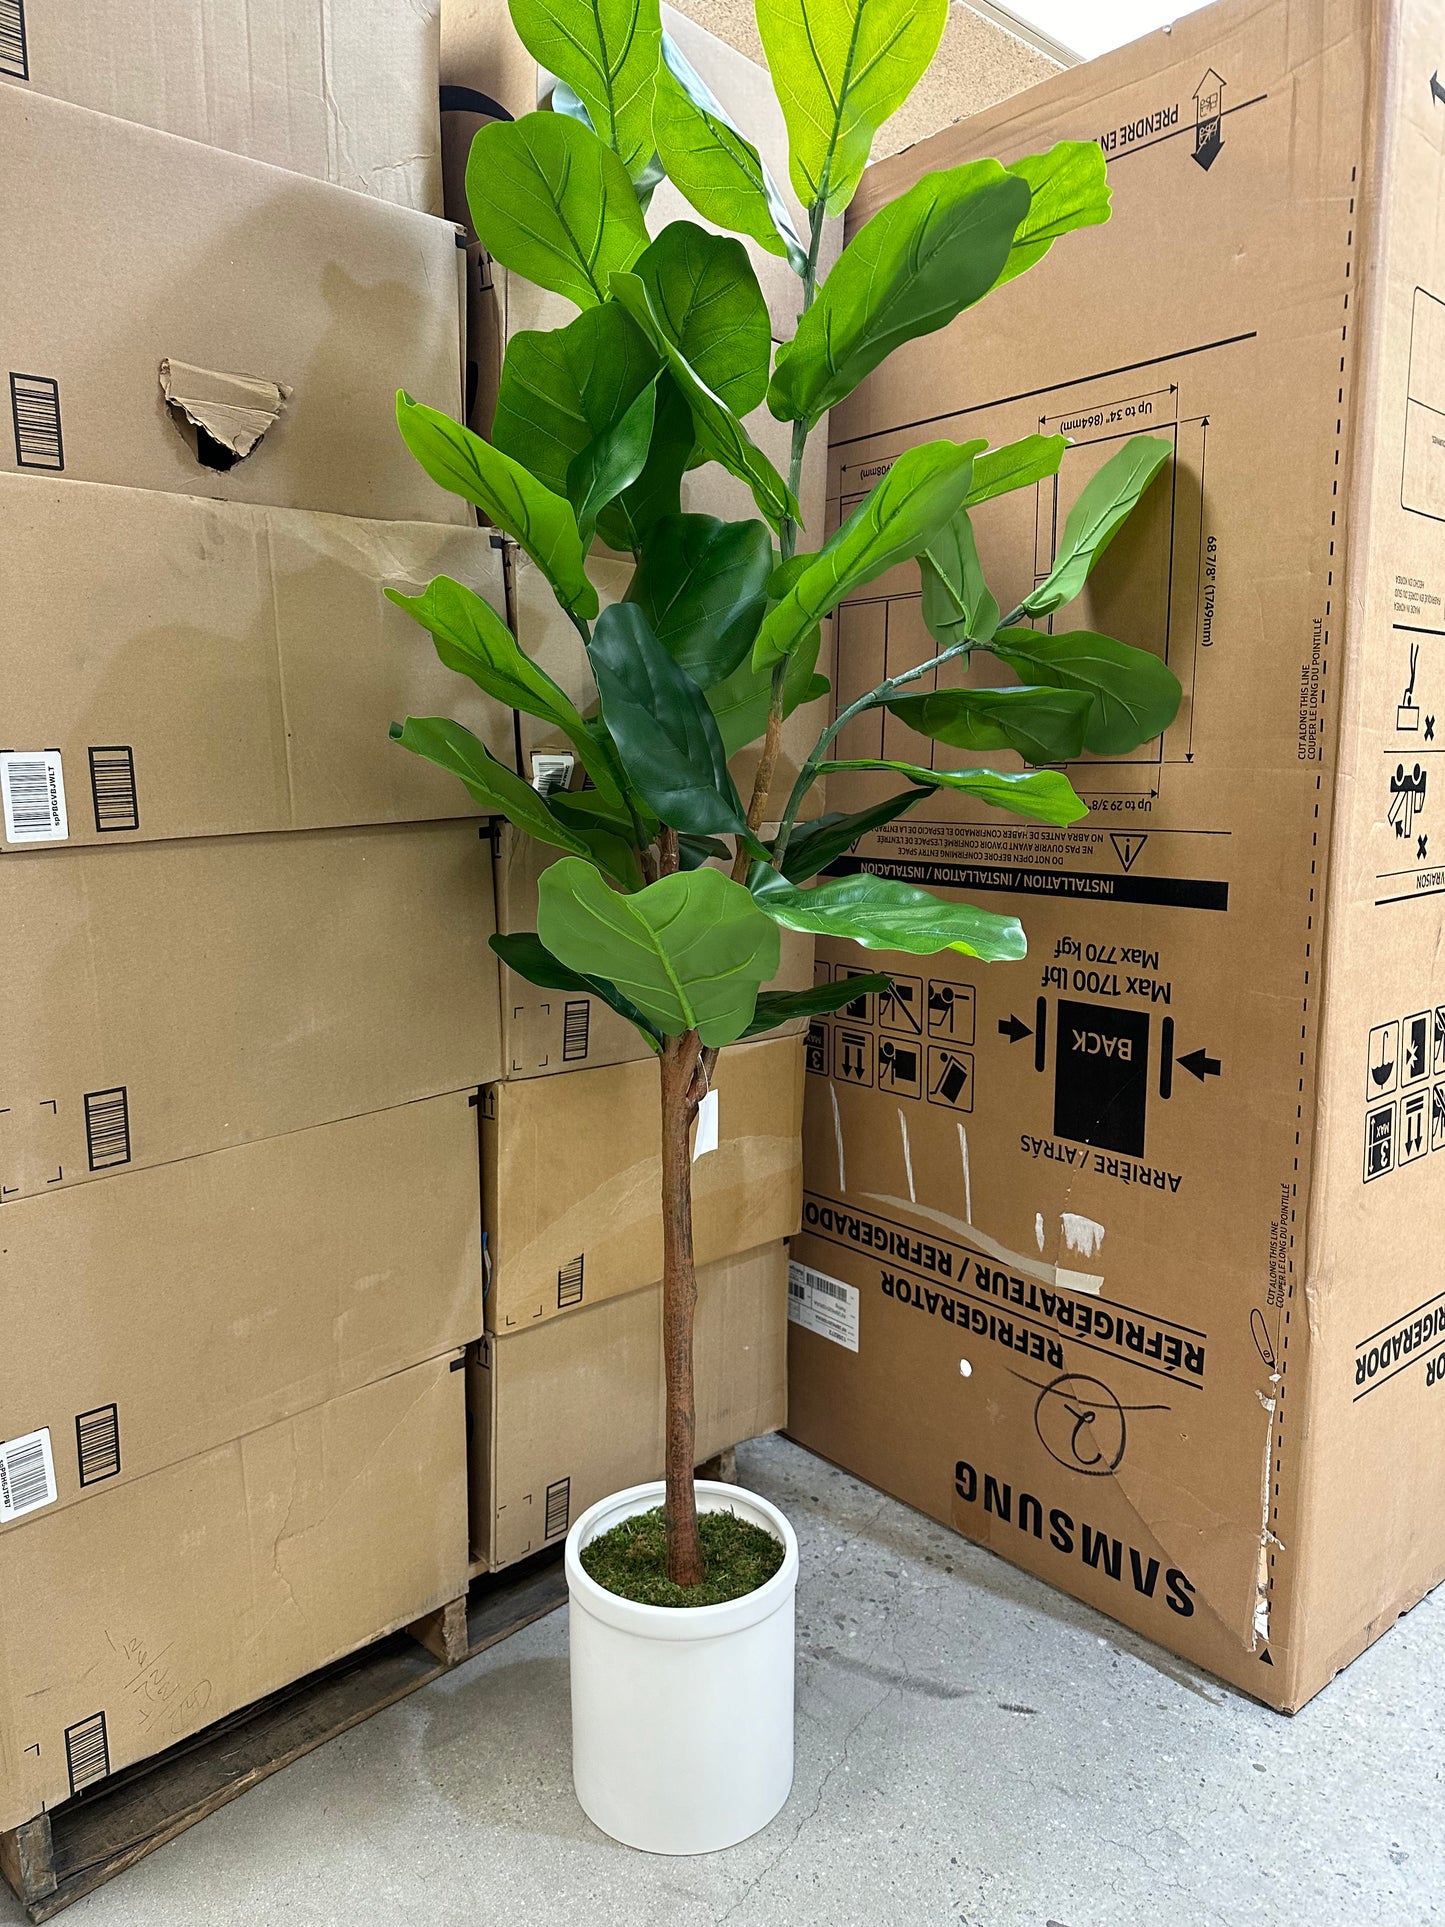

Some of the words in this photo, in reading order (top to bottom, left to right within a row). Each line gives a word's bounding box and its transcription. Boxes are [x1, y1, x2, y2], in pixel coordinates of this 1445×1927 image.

[1119, 103, 1179, 146] PRENDRE
[1101, 130, 1117, 152] EN
[1125, 406, 1136, 417] to
[1138, 400, 1153, 415] Up
[1060, 412, 1104, 435] (864mm)
[1105, 409, 1123, 424] 34"
[1206, 535, 1217, 553] 68
[1205, 554, 1217, 581] 7/8"
[1201, 584, 1216, 647] (1749mm)
[1312, 617, 1323, 665] POINTILLÉ
[1301, 664, 1310, 686] LINE
[1311, 667, 1320, 681] DU
[1300, 687, 1309, 708] THIS
[1310, 683, 1318, 708] LONG
[1309, 710, 1317, 721] LE
[1299, 709, 1308, 741] ALONG
[1307, 723, 1317, 760] COUPER
[1298, 742, 1306, 760] CUT
[1110, 800, 1123, 811] 29
[1124, 800, 1136, 811] to
[1137, 798, 1152, 811] Up
[899, 825, 907, 833] LA
[908, 826, 917, 834] DE
[918, 826, 945, 836] ESPACIO
[946, 827, 954, 836] EL
[954, 828, 1002, 838] CONFIRMADO
[1002, 829, 1028, 839] HABER
[1029, 831, 1039, 840] DE
[1041, 831, 1066, 841] ANTES
[1068, 832, 1090, 842] ABRA
[1091, 833, 1104, 842] NO
[876, 835, 904, 844] L'ENTRÉE
[905, 836, 914, 845] DE
[914, 837, 944, 847] L'ESPACE
[944, 838, 979, 849] CONFIRMÉ
[979, 840, 1008, 850] D'AVOIR
[1009, 841, 1033, 851] AVANT
[1034, 843, 1064, 853] OUVRIR
[898, 847, 918, 856] SPACE
[919, 848, 939, 858] ENTRY
[940, 849, 983, 860] CONFIRMING
[983, 852, 1012, 862] BEFORE
[1065, 844, 1081, 854] PAS
[1082, 845, 1093, 854] NE
[1013, 854, 1034, 864] OPEN
[1035, 855, 1051, 865] NOT
[1052, 856, 1064, 865] DO
[926, 866, 932, 879] /
[934, 867, 1013, 886] INSTALLATION
[1014, 872, 1021, 887] /
[1023, 874, 1114, 894] INSTALLATION
[1053, 936, 1082, 961] kgf
[1086, 943, 1118, 965] 770
[1120, 947, 1159, 970] Max
[1041, 965, 1068, 990] lbf
[1073, 969, 1122, 997] 1700
[1125, 976, 1172, 1005] Max
[1071, 1028, 1133, 1062] BACK
[811, 1050, 821, 1069] 3
[1376, 1121, 1390, 1138] MAX
[1020, 1134, 1078, 1165] ATRÁS
[1380, 1140, 1389, 1167] 3
[1079, 1149, 1090, 1169] /
[1093, 1154, 1183, 1193] ARRIÈRE
[1280, 1182, 1290, 1226] POINTILLÉ
[1271, 1220, 1279, 1241] LINE
[1280, 1226, 1288, 1239] DU
[803, 1201, 953, 1278] REFRIGERADO
[1270, 1241, 1278, 1258] THIS
[1278, 1240, 1287, 1263] LONG
[958, 1256, 971, 1283] /
[1269, 1260, 1277, 1289] ALONG
[1278, 1263, 1286, 1275] LE
[1266, 1288, 1276, 1305] CUT
[1275, 1275, 1286, 1308] COUPER
[880, 1270, 1064, 1371] REFRIGERATOR
[974, 1262, 1206, 1377] RÉFRIGÉRATEUR
[954, 1460, 1196, 1618] SAMSUNG
